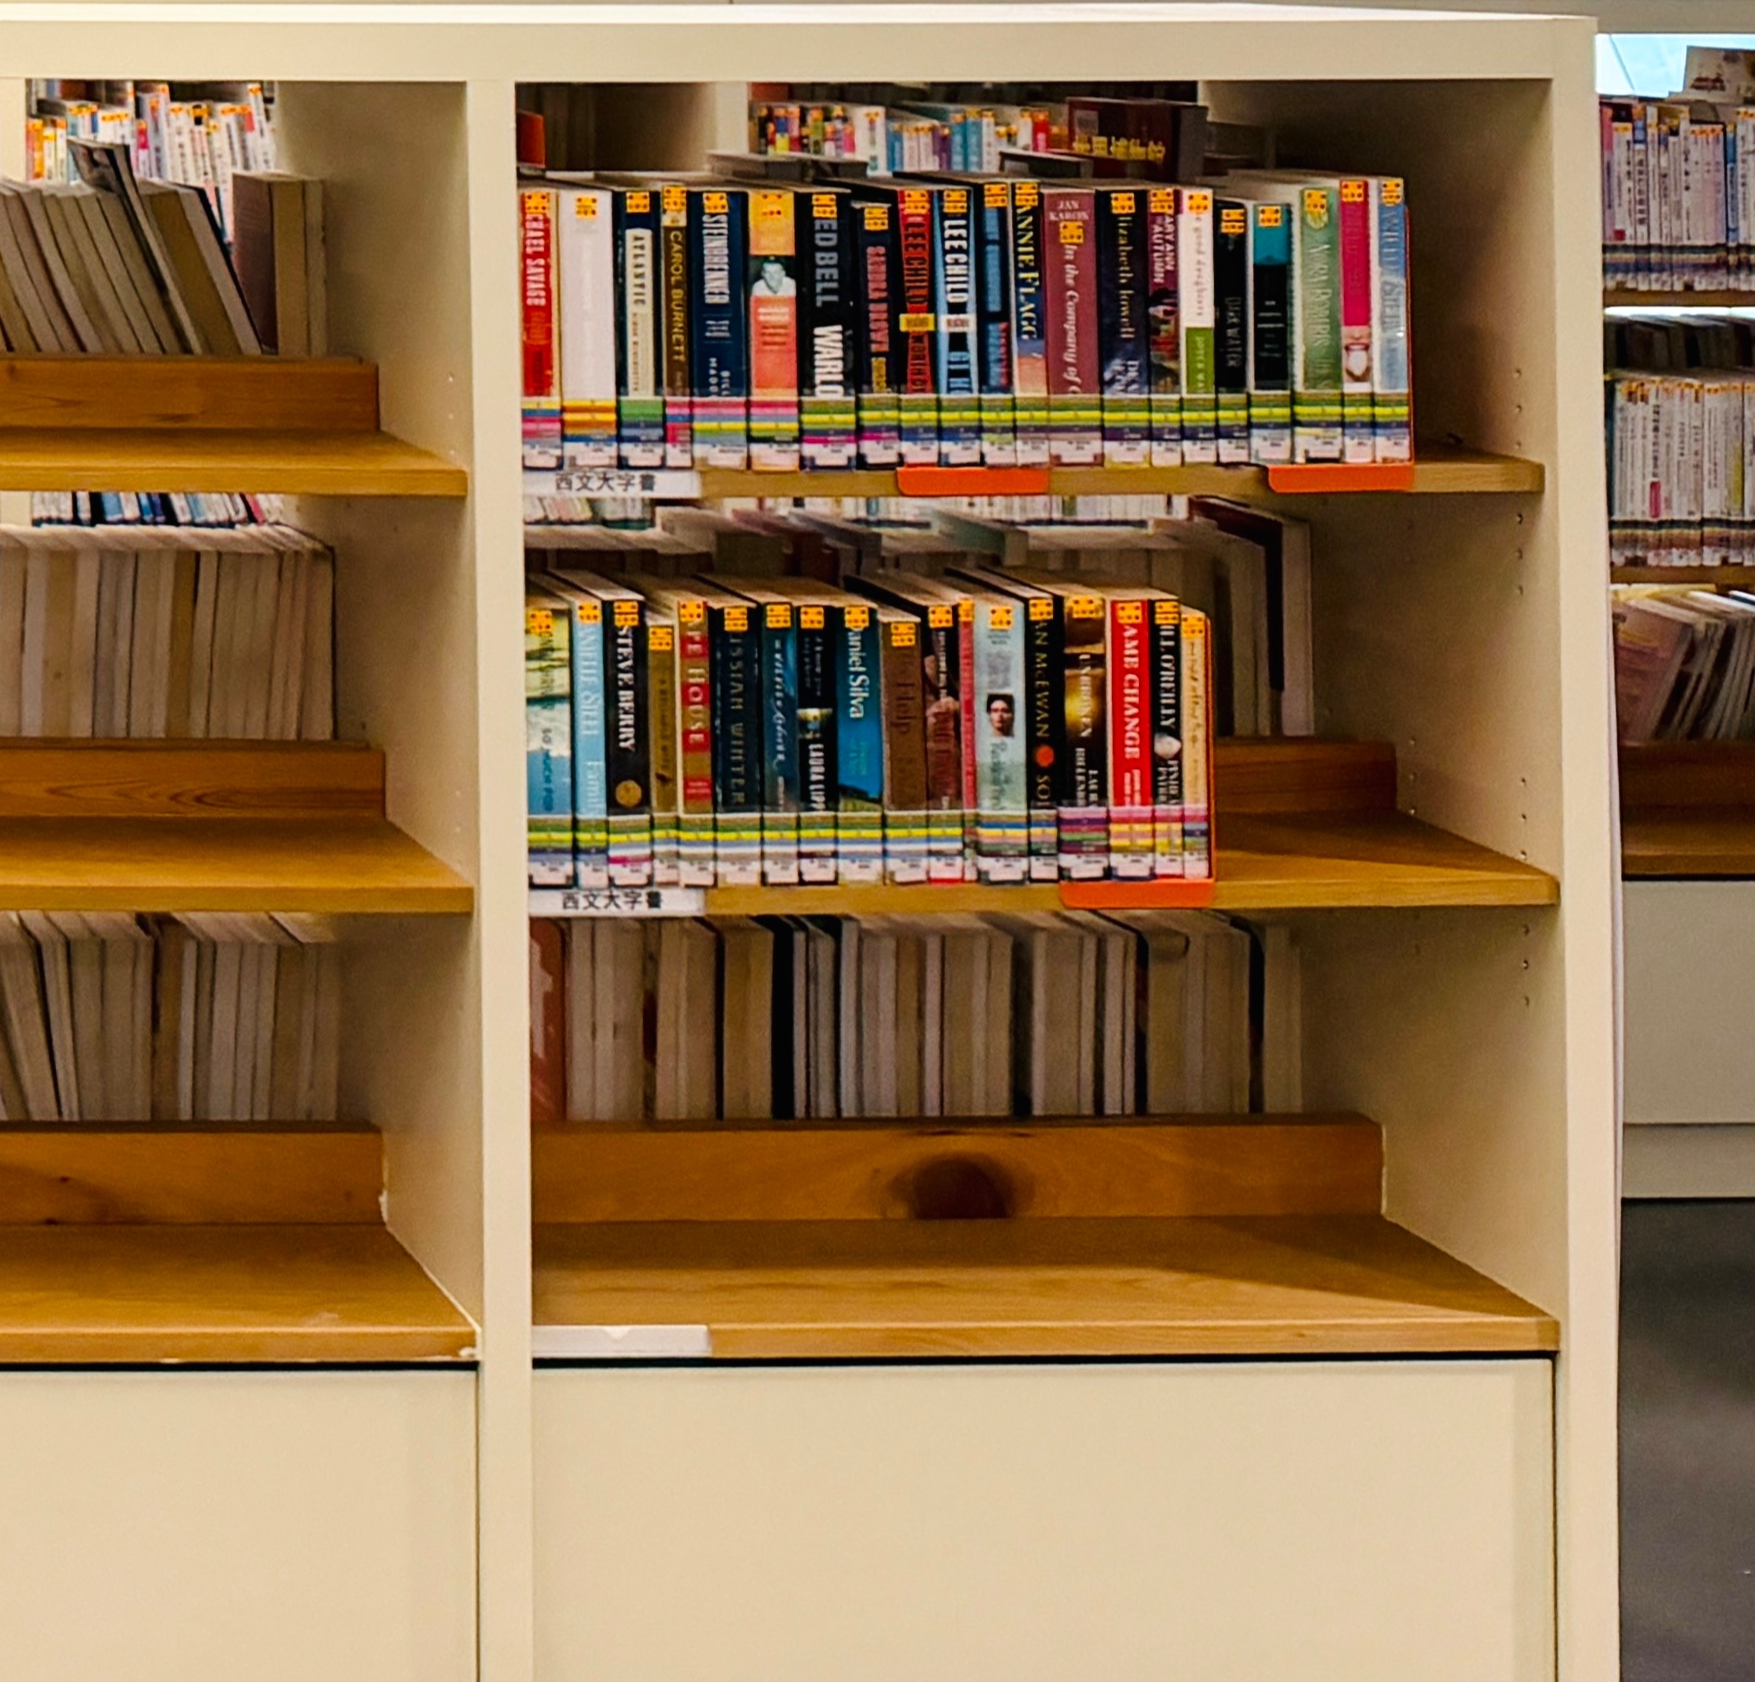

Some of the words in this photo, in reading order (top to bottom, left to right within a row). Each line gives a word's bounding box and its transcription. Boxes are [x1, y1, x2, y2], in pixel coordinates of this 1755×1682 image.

[1058, 200, 1079, 209] JAN
[1164, 215, 1175, 241] ARY
[525, 214, 545, 254] CHAEL
[670, 230, 683, 285] CAROL
[815, 219, 838, 246] ED
[905, 223, 926, 251] LEE
[944, 220, 967, 249] LEE
[1016, 205, 1035, 267] ANNIE
[1063, 245, 1080, 260] In
[1118, 216, 1135, 283] lizabeth
[1152, 225, 1165, 283] AUTUMN
[633, 235, 645, 306] ATLANTIC
[816, 252, 839, 307] BELL
[905, 257, 928, 305] CHILD
[945, 254, 970, 303] CHILD
[1064, 265, 1080, 286] the
[671, 289, 685, 362] BURNETT
[1063, 290, 1082, 362] Company
[813, 325, 845, 397] WARLO
[1065, 367, 1082, 382] of
[578, 627, 597, 687] ANIELLE
[616, 626, 634, 686] STEVE
[1122, 625, 1139, 669] AME
[1159, 625, 1174, 652] ILL
[618, 690, 636, 751] BERRY
[849, 675, 870, 718] Silva
[1034, 652, 1050, 738] McEWAN
[1123, 673, 1140, 759] CHANGE
[585, 760, 603, 815] Famil
[729, 722, 745, 805] WINTER
